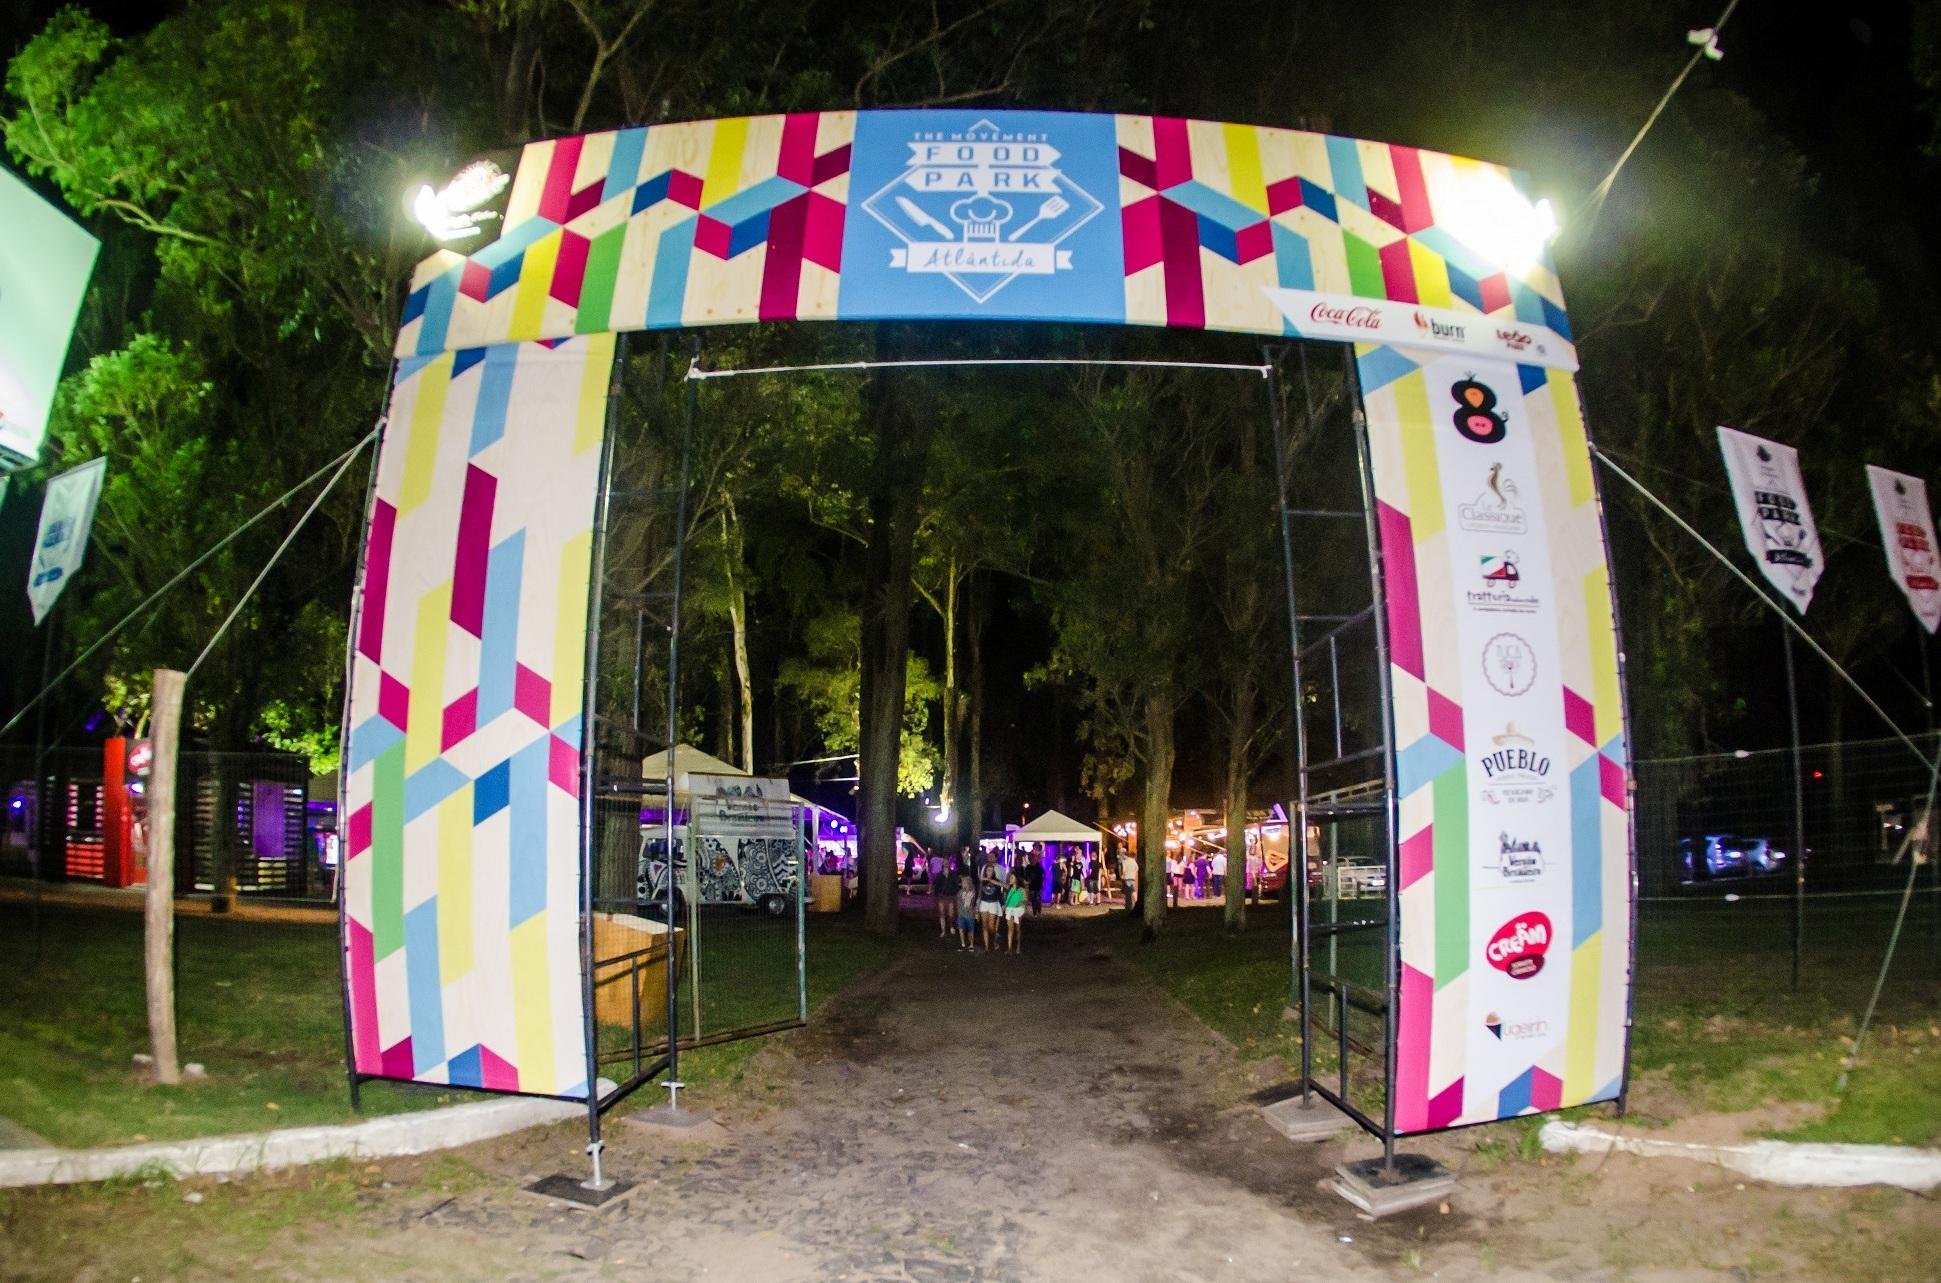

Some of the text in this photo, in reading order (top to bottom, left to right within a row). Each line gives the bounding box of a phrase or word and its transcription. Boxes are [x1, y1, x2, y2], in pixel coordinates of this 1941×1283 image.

[914, 132, 1049, 142] THE MOVEMENT
[926, 146, 1041, 162] FOOD
[924, 172, 1041, 188] PARK
[1430, 318, 1465, 339] burn
[1481, 749, 1551, 778] PUEBLO
